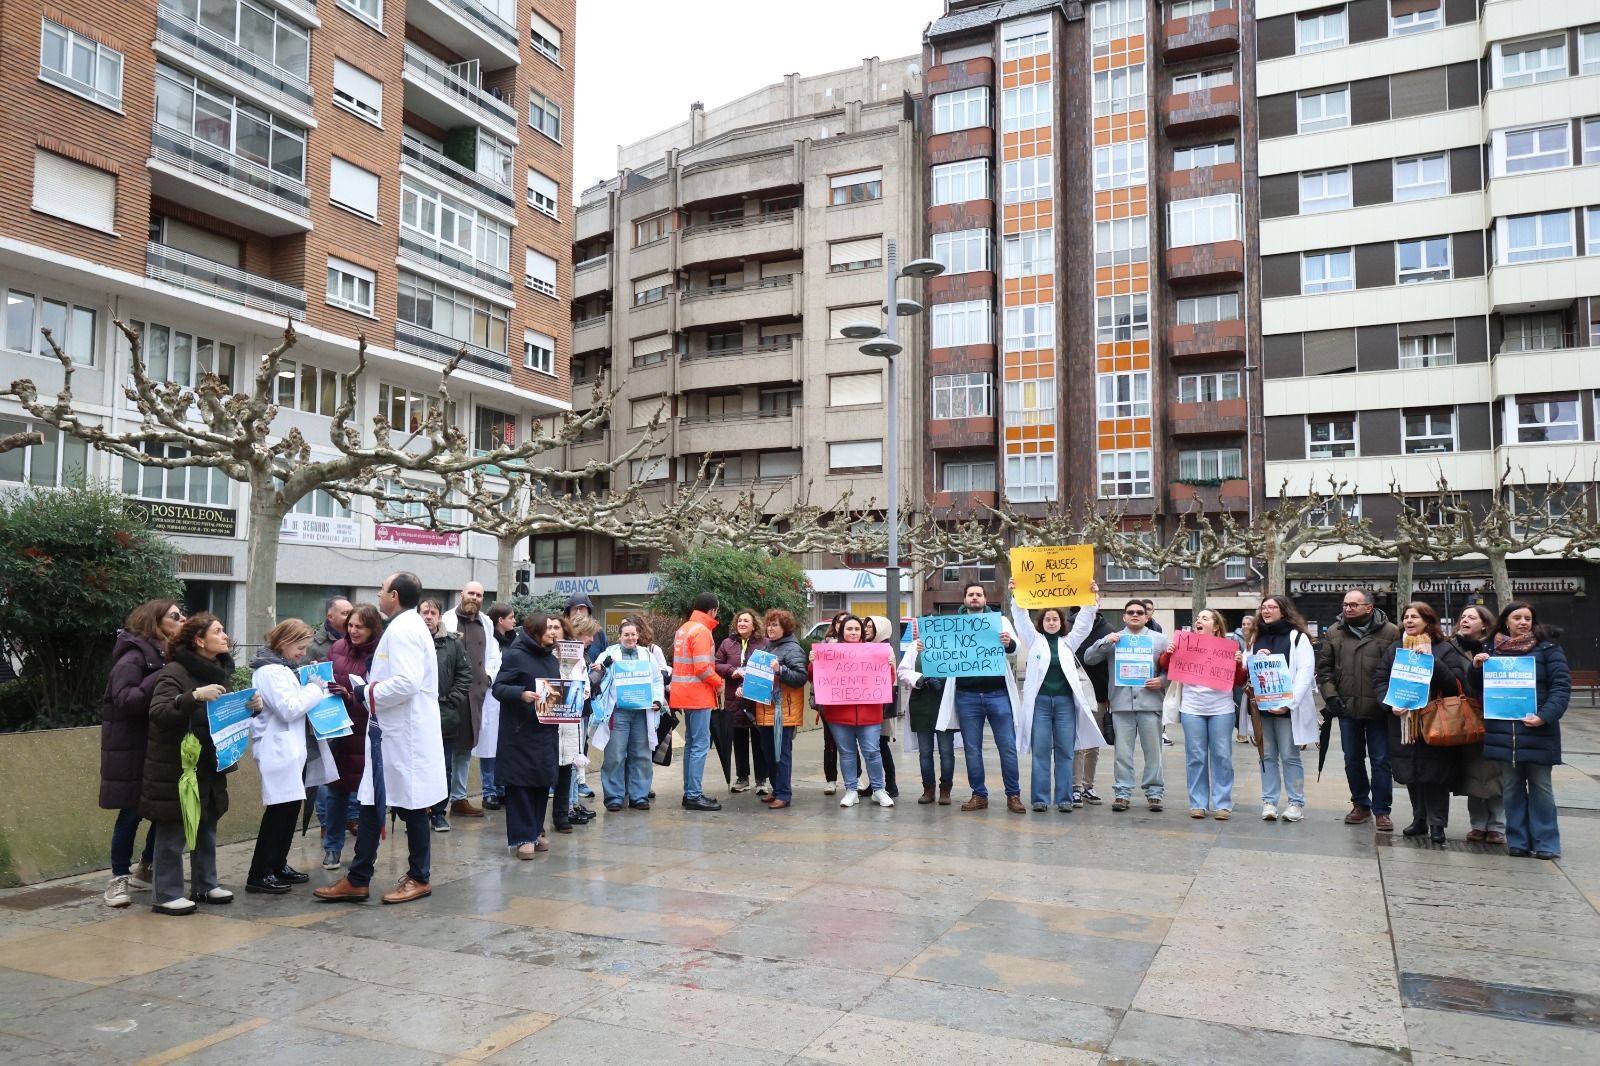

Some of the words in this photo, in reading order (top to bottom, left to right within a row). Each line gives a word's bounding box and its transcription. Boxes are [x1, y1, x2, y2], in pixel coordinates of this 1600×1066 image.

[151, 504, 222, 521] POSTALEON
[302, 520, 330, 533] SEGUROS
[1021, 560, 1034, 572] NO
[1045, 558, 1077, 570] ABUSES
[1035, 573, 1046, 584] DE
[1051, 572, 1067, 582] MI
[557, 578, 600, 593] ABANCA
[1029, 584, 1078, 598] VOCACIÓN
[1418, 579, 1471, 593] Omña
[1484, 578, 1575, 592] Rtaurante
[924, 635, 948, 650] QUE
[954, 634, 978, 649] NOS
[924, 650, 968, 663] CUIDEN
[975, 646, 1004, 659] PARA
[835, 662, 889, 673] AGOTADO
[1484, 671, 1507, 679] HUELGA
[1507, 670, 1533, 679] MÉDICA
[818, 675, 867, 686] PACIENTE
[874, 675, 887, 686] EN
[831, 687, 883, 700] RIESGO
